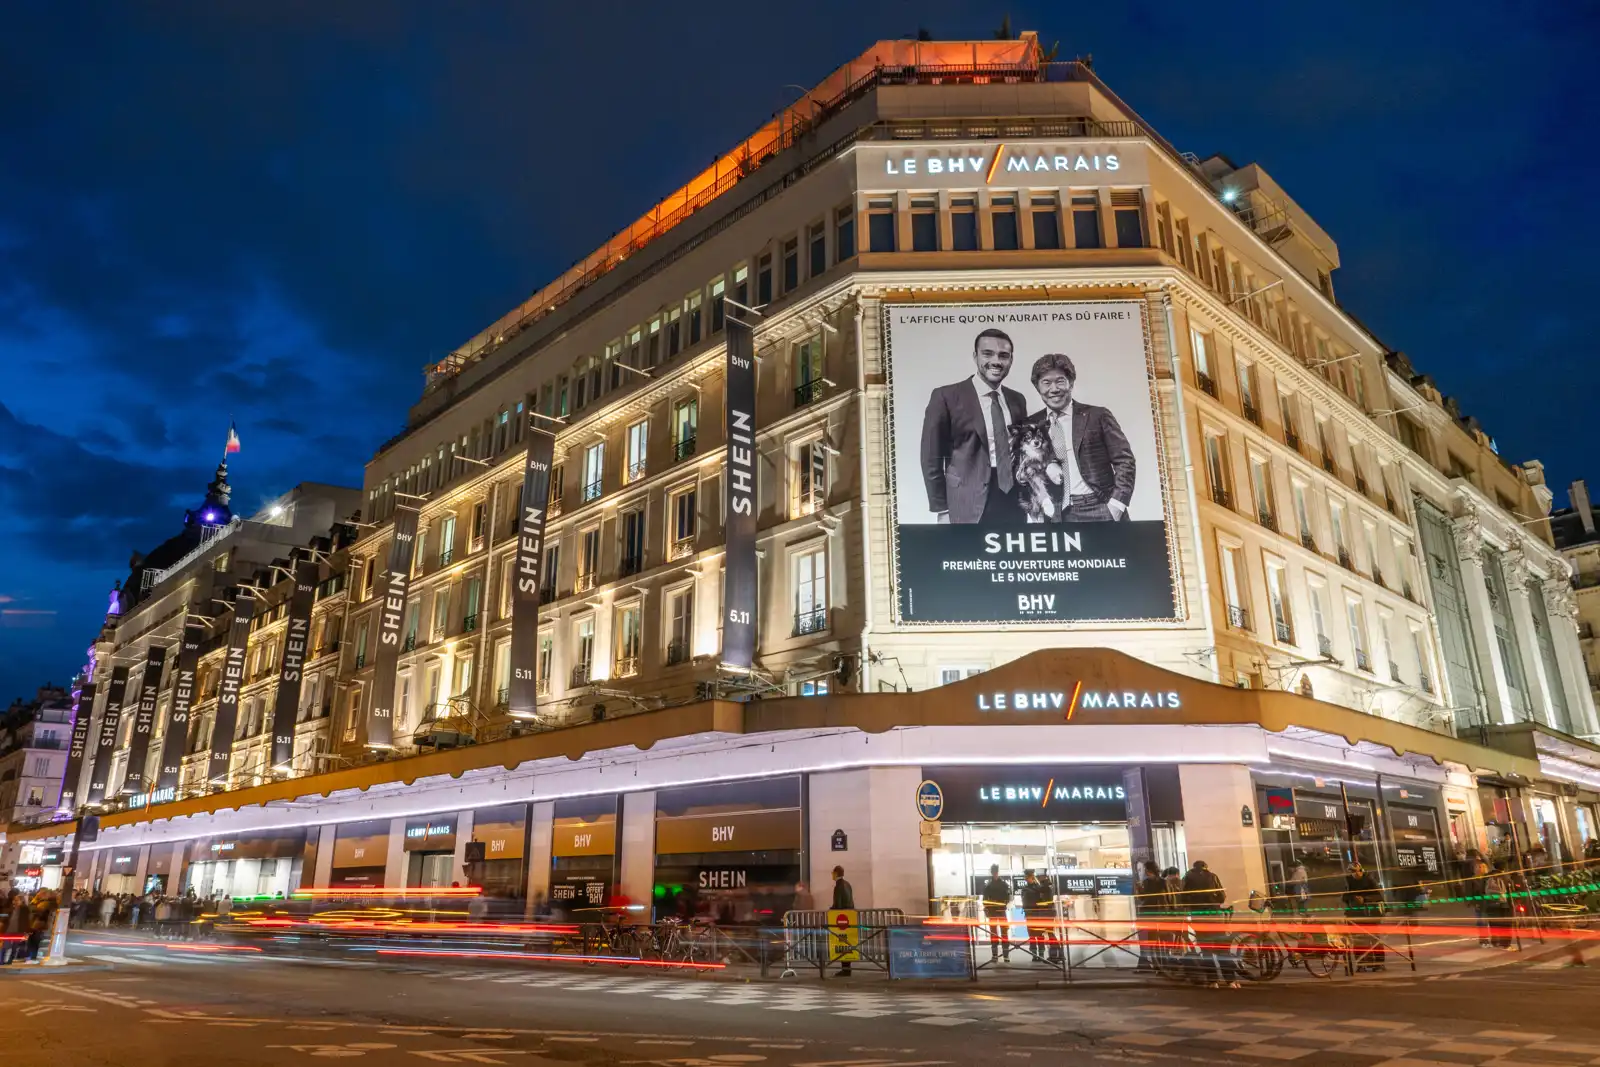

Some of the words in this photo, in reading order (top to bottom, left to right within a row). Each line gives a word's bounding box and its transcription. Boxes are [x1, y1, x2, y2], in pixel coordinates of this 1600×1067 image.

[887, 158, 916, 174] LE
[928, 157, 984, 173] BHV
[1007, 155, 1120, 172] MARAIS
[900, 316, 956, 324] L'AFFICHE
[958, 315, 994, 324] QU'ON
[998, 313, 1048, 322] N'AURAIT
[1052, 312, 1073, 322] PAS
[1076, 310, 1091, 321] DÛ
[1094, 312, 1124, 320] FAIRE
[732, 356, 750, 370] BHV
[530, 460, 548, 472] BHV
[732, 410, 752, 516] SHEIN
[397, 532, 412, 542] BHV
[984, 531, 1082, 554] SHEIN
[520, 506, 542, 594] SHEIN
[942, 558, 996, 570] PREMIÈRE
[1000, 558, 1064, 570] OUVERTURE
[1068, 558, 1126, 568] MONDIALE
[992, 572, 1006, 582] LE
[1008, 572, 1014, 582] 5
[1018, 571, 1079, 582] NOVEMBRE
[382, 572, 407, 646] SHEIN
[1018, 594, 1056, 610] BHV
[730, 610, 750, 624] 5.11
[284, 618, 307, 682] SHEIN
[222, 647, 244, 704] SHEIN
[515, 668, 532, 680] 5.11
[174, 670, 194, 722] SHEIN
[980, 694, 1006, 710] LE
[1015, 692, 1064, 709] BHV
[1082, 692, 1181, 708] MARAIS
[138, 686, 156, 733] SHEIN
[374, 708, 390, 718] 5.11
[101, 702, 120, 746] SHEIN
[71, 717, 88, 758] SHEIN
[980, 788, 1000, 800] LE
[1006, 787, 1042, 800] BHV
[1055, 786, 1125, 799] MARAIS
[408, 828, 415, 837] LE
[712, 826, 735, 841] BHV
[492, 840, 505, 851] BHV
[574, 834, 591, 848] BHV
[1398, 854, 1417, 866] SHEIN
[700, 870, 746, 887] SHEIN
[554, 889, 575, 899] SHEIN
